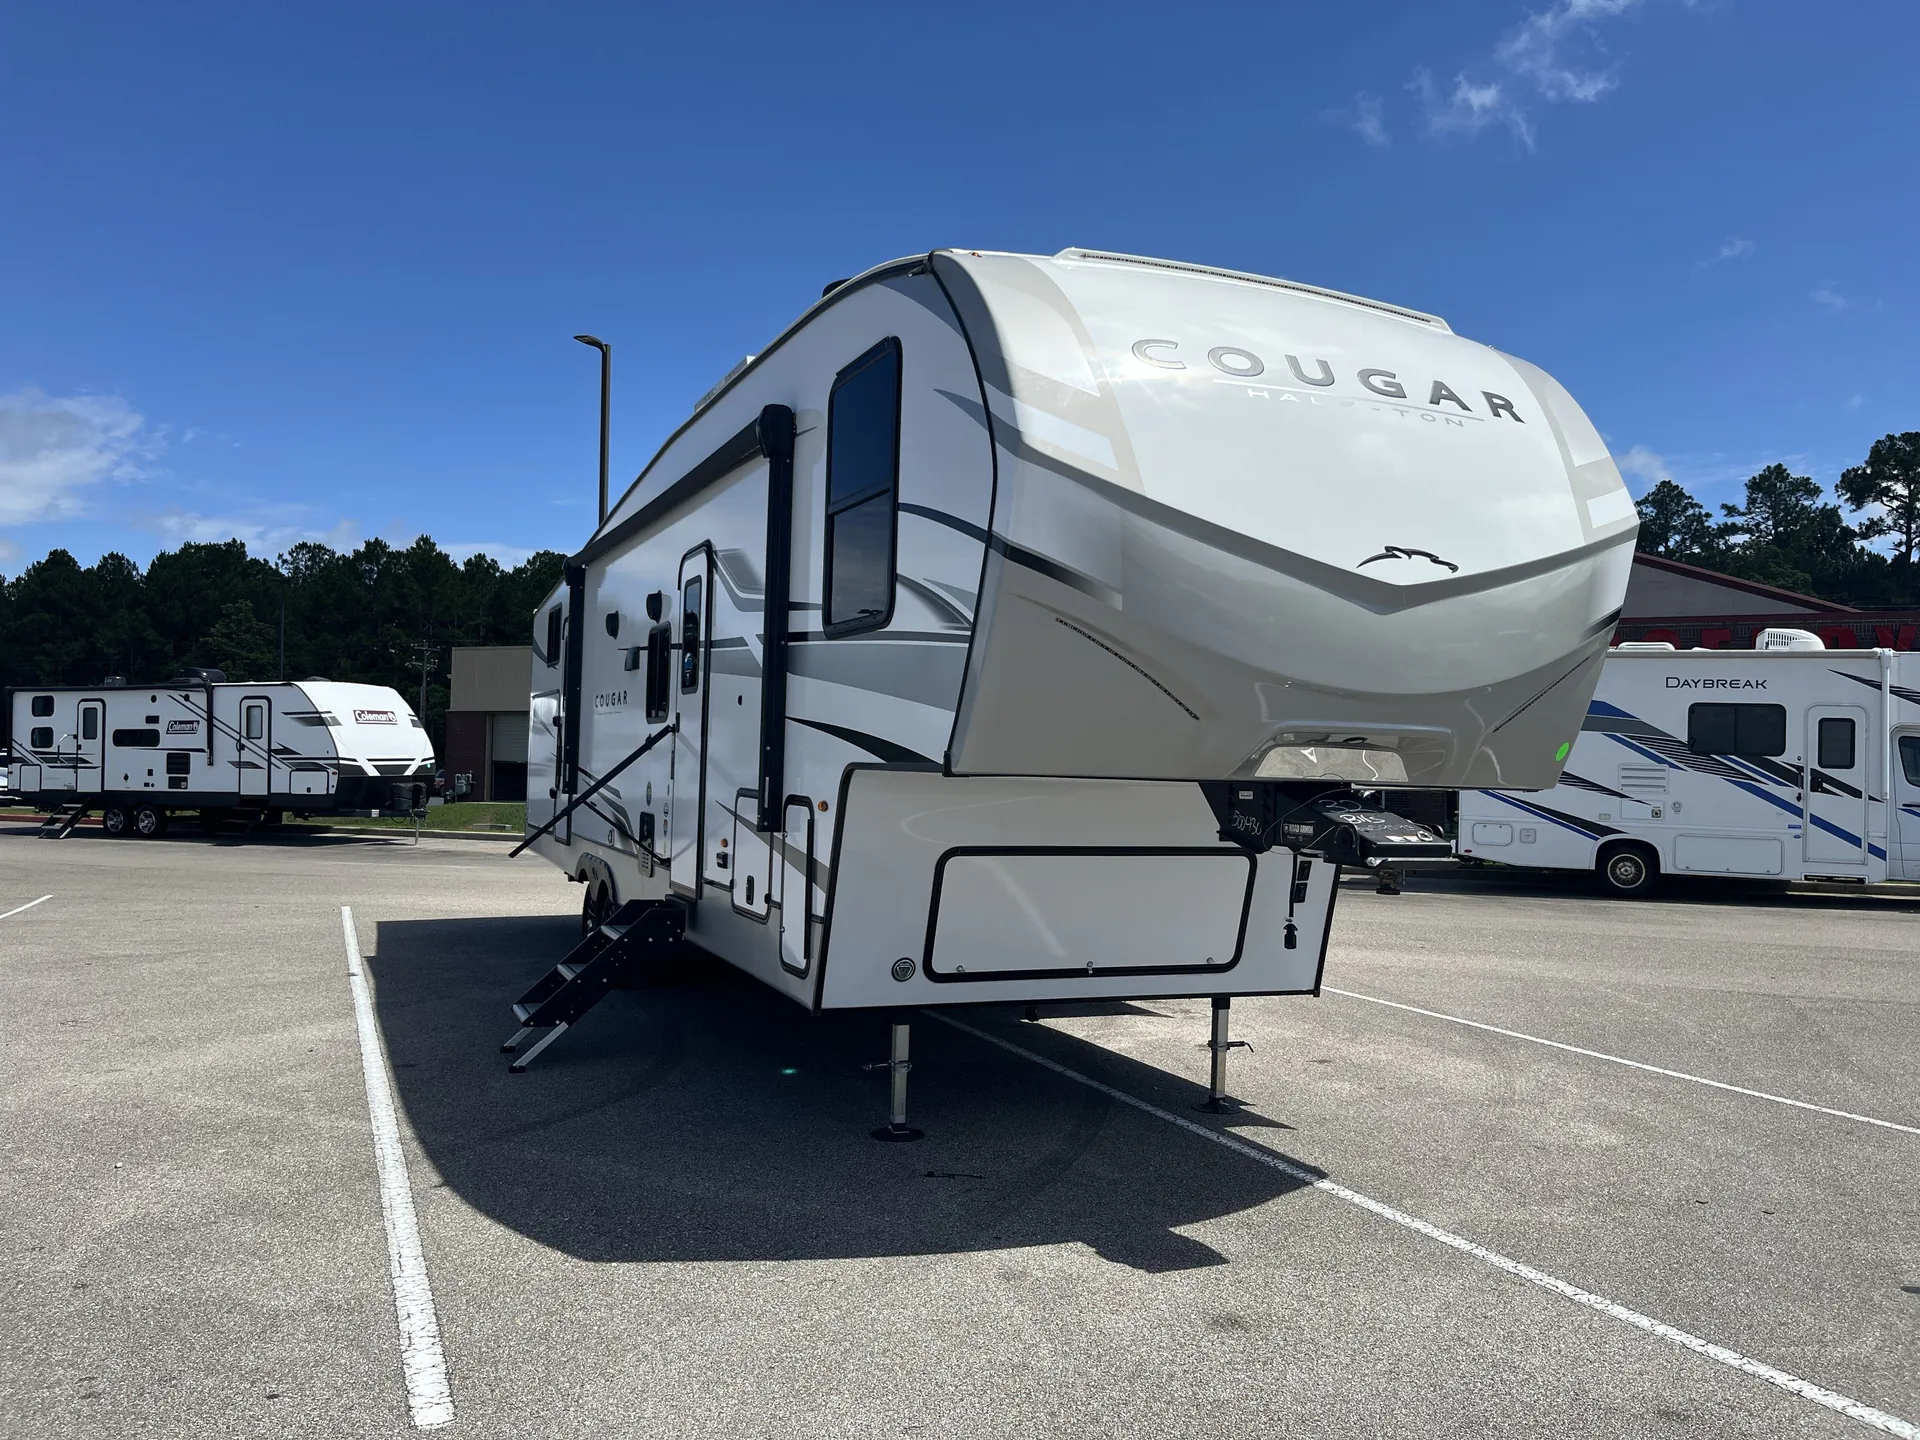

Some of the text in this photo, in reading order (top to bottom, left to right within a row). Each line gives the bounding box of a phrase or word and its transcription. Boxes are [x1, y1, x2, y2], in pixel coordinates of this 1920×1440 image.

[1131, 338, 1526, 425] COUGAR
[1246, 388, 1465, 428] HAL-TON
[1665, 676, 1768, 690] DAYBREAK
[594, 689, 628, 709] COUGAR
[354, 710, 390, 722] Coleman
[168, 721, 193, 731] Coleman
